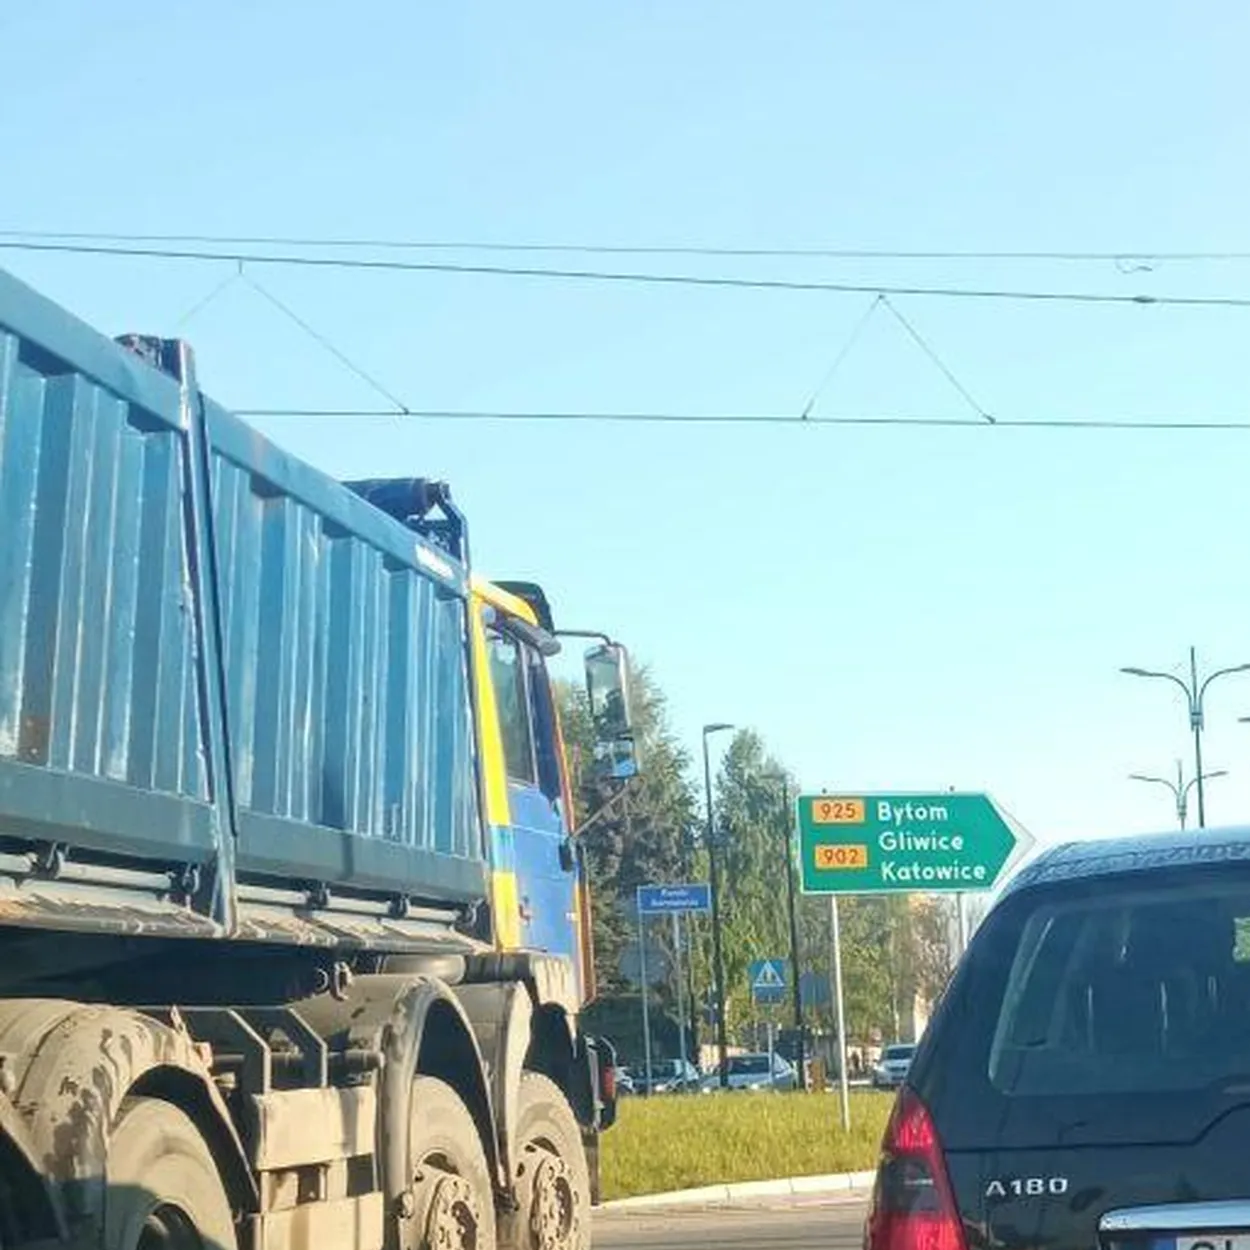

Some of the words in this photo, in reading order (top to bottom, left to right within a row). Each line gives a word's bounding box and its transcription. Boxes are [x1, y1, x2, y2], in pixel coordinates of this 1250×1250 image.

[821, 803, 856, 819] 925
[877, 801, 948, 826] Bytom
[878, 830, 964, 851] Gliwice
[824, 848, 859, 864] 902
[881, 861, 987, 882] Katowice
